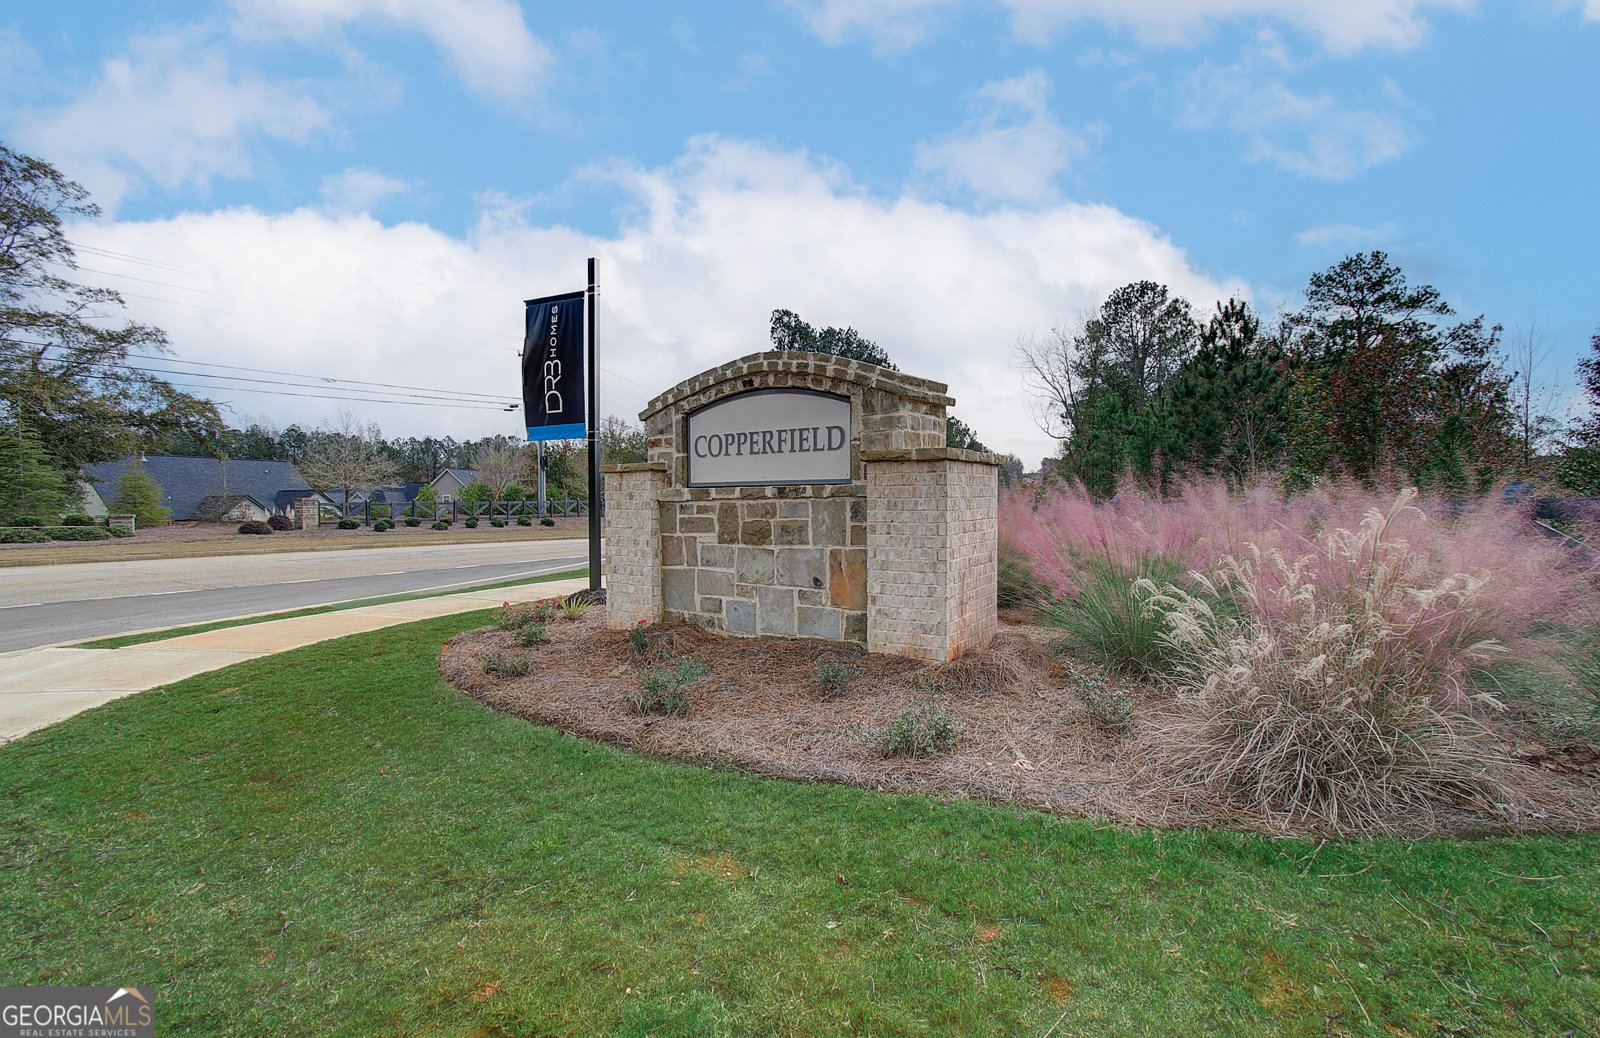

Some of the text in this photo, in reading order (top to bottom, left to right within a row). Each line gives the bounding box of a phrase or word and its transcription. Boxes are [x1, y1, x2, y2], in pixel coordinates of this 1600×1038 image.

[544, 305, 563, 414] DRB HOMES
[694, 425, 846, 459] COPPERFIELD
